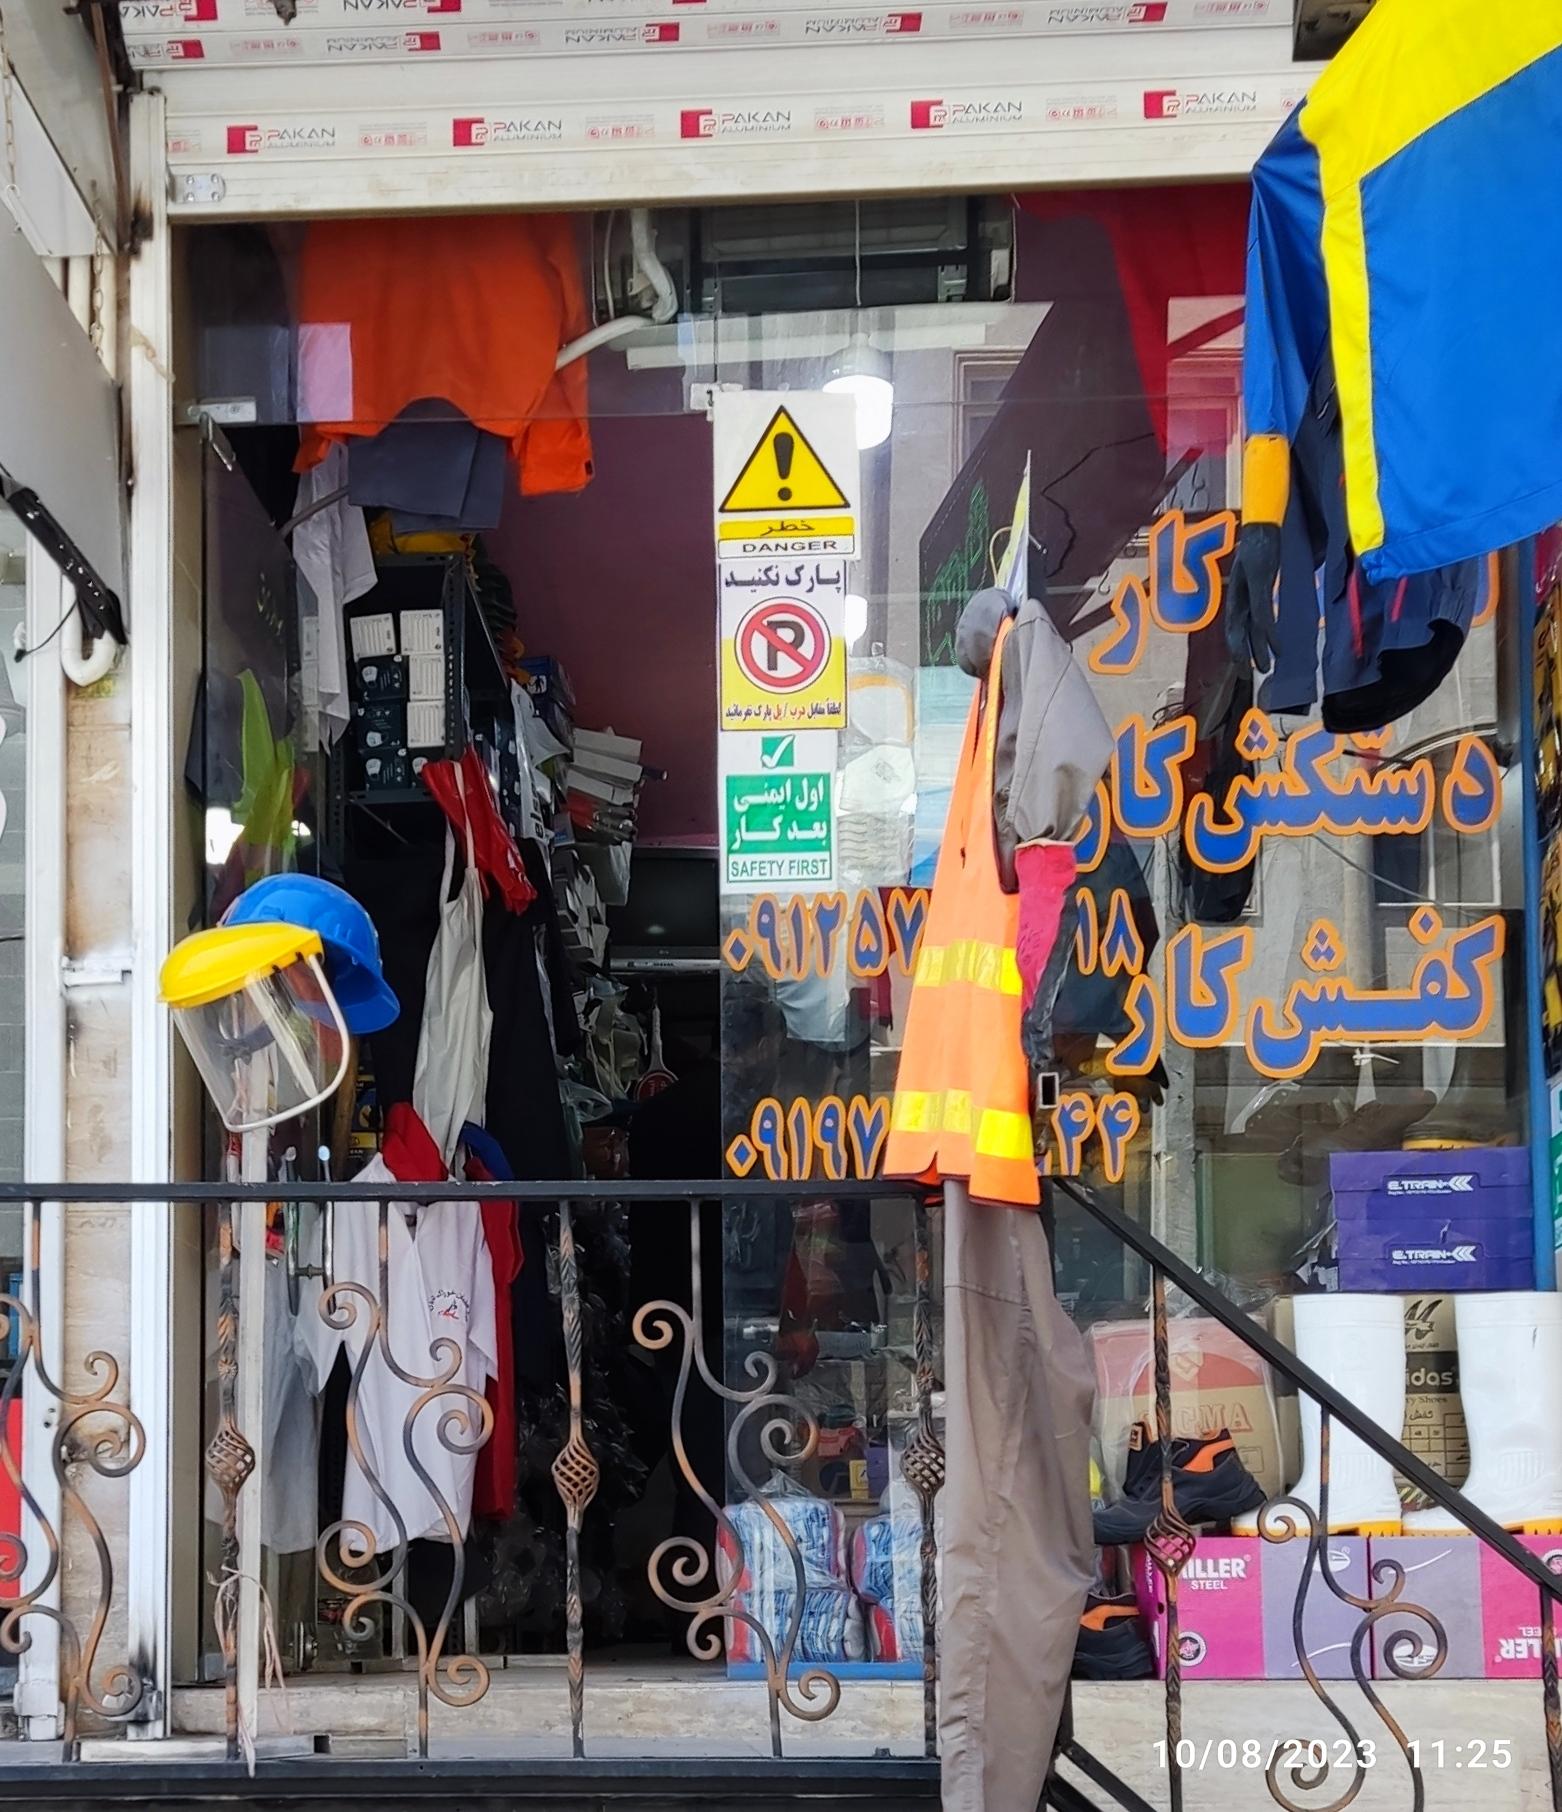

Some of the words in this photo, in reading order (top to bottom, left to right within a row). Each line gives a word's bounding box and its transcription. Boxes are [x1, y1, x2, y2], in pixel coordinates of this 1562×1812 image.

[120, 4, 174, 18] PAKA
[953, 101, 1022, 115] PAKAN
[1185, 91, 1257, 104] PAKAN
[494, 119, 562, 133] PAKAN
[722, 111, 791, 124] PAKAN
[267, 126, 335, 140] PAKAN
[760, 520, 815, 536] خطر
[742, 540, 838, 553] DANGER
[725, 565, 780, 593] نکنید
[785, 564, 841, 593] پارک
[1090, 509, 1236, 675] کار
[733, 778, 792, 812] ایمنی
[795, 776, 824, 812] اول
[1073, 712, 1197, 873] کار
[730, 814, 784, 850] کار
[787, 820, 828, 847] بعد
[731, 860, 785, 877] SAFETY
[788, 858, 828, 876] FIRST
[1104, 921, 1254, 1076] کار
[1244, 904, 1507, 1080] کفش
[1191, 1580, 1229, 1590] STEEL
